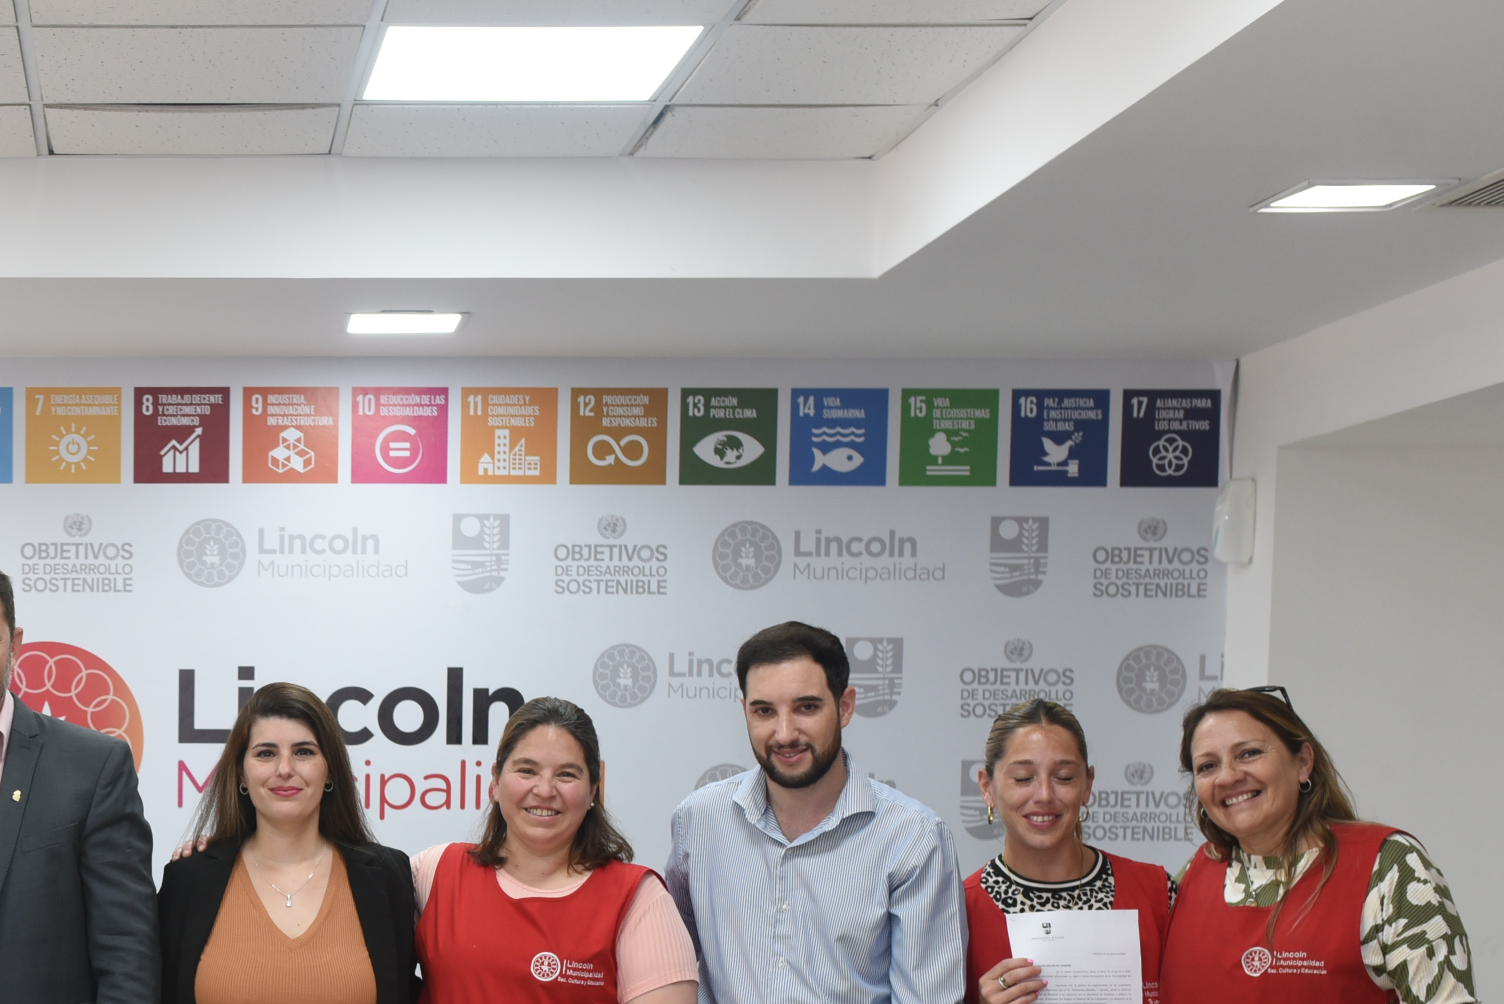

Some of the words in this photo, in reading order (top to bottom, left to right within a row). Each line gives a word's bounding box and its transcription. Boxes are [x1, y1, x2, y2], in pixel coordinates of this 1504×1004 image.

[34, 395, 44, 416] 7
[142, 395, 153, 416] 8
[158, 394, 191, 404] TRABAJO
[192, 394, 223, 404] DECENTE
[251, 394, 262, 415] 9
[356, 394, 376, 416] 10
[421, 394, 430, 405] DE
[431, 394, 445, 405] LAS
[467, 395, 482, 416] 11
[524, 395, 529, 404] Y
[577, 395, 595, 416] 12
[823, 397, 840, 406] VIDA
[933, 398, 950, 407] VIDA
[1060, 398, 1094, 408] JUSTICIA
[1156, 398, 1191, 408] ALIANZAS
[1192, 398, 1211, 408] PARA
[51, 406, 56, 416] Y
[56, 406, 65, 416] NO
[158, 405, 164, 415] Y
[164, 405, 210, 415] CRECIMIENTO
[310, 404, 315, 414] E
[380, 406, 438, 416] DESIGUALDADES
[488, 406, 540, 416] COMUNIDADES
[603, 406, 608, 416] Y
[609, 406, 644, 416] CONSUMO
[686, 395, 704, 417] 13
[797, 396, 816, 417] 14
[909, 396, 926, 417] 15
[1019, 396, 1037, 418] 16
[1131, 396, 1148, 418] 17
[710, 408, 726, 418] POR
[727, 408, 734, 418] EL
[735, 408, 757, 418] CLIMA
[822, 408, 865, 418] SUBMARINA
[933, 408, 942, 418] DE
[942, 408, 990, 418] ECOSISTEMAS
[1044, 410, 1048, 420] E
[1156, 410, 1184, 418] LOGRAR
[267, 416, 334, 426] INFRAESTRUCTURA
[488, 417, 534, 426] SOSTENIBLES
[602, 418, 657, 427] RESPONSABLES
[1155, 420, 1169, 430] LOS
[1170, 420, 1210, 430] OBJETIVOS
[257, 527, 380, 555] Lincoln
[794, 529, 917, 558] Lincoln
[20, 542, 133, 561] OBJETIVOS
[554, 544, 668, 562] OBJETIVOS
[1093, 546, 1209, 565] OBJETIVOS
[22, 563, 40, 576] DE
[43, 563, 133, 576] DESARROLLO
[256, 559, 409, 582] Municipalidad
[555, 565, 573, 578] DE
[576, 565, 668, 578] DESARROLLO
[793, 561, 945, 584] Municipalidad
[1093, 568, 1112, 580] DE
[1115, 568, 1208, 580] DESARROLLO
[21, 578, 133, 593] SOSTENIBLE
[554, 579, 668, 595] SOSTENIBLE
[1093, 582, 1208, 598] SOSTENIBLE
[668, 652, 736, 678] Linc
[960, 668, 1074, 686] OBJETIVOS
[961, 688, 979, 700] DE
[982, 688, 1074, 700] DESARROLLO
[178, 666, 526, 746] Licoln
